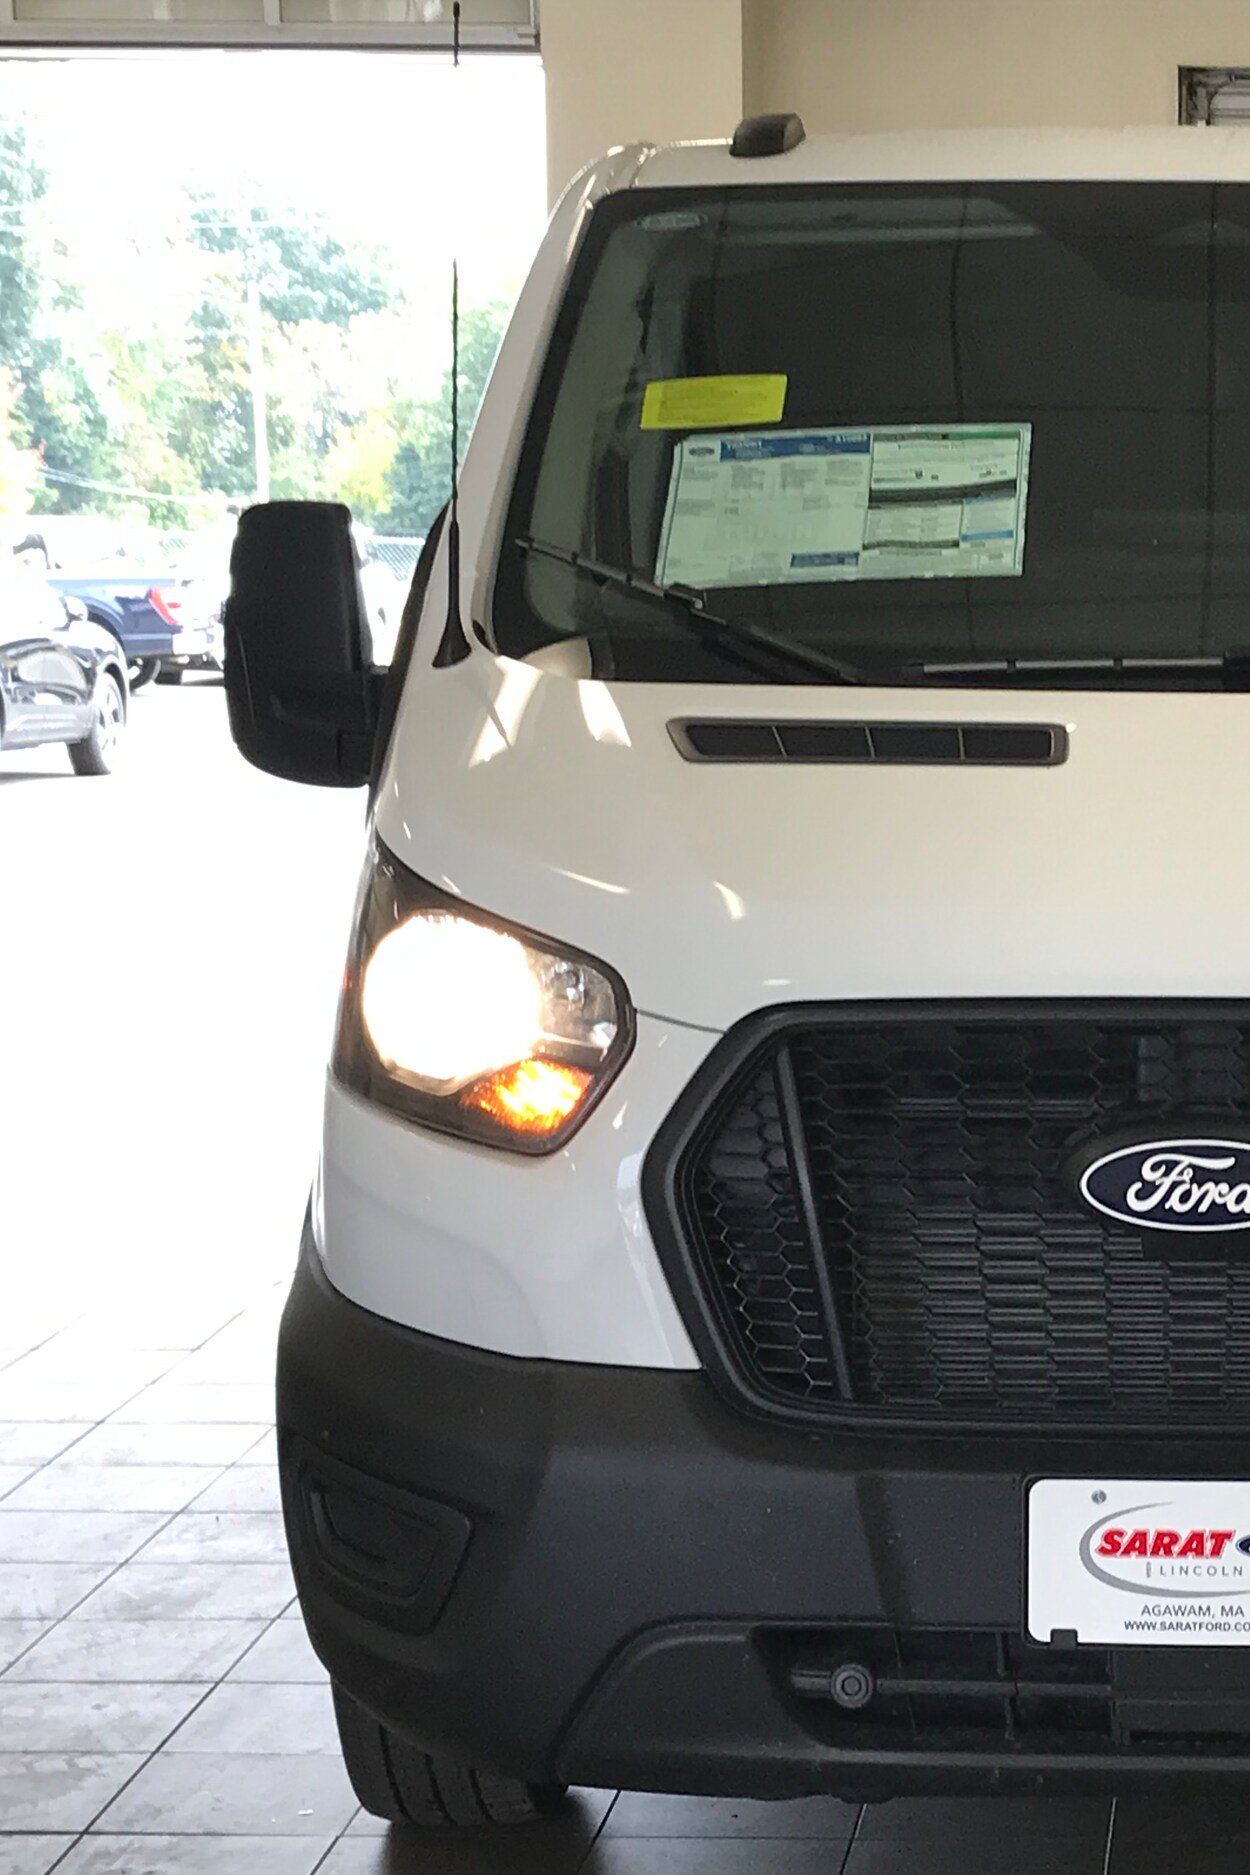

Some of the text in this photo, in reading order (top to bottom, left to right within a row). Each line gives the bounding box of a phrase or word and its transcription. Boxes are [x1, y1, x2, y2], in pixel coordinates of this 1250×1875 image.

[1096, 1529, 1237, 1559] SARAT
[1159, 1565, 1243, 1576] LINCOLN
[1141, 1605, 1245, 1618] AGAWAM, MA
